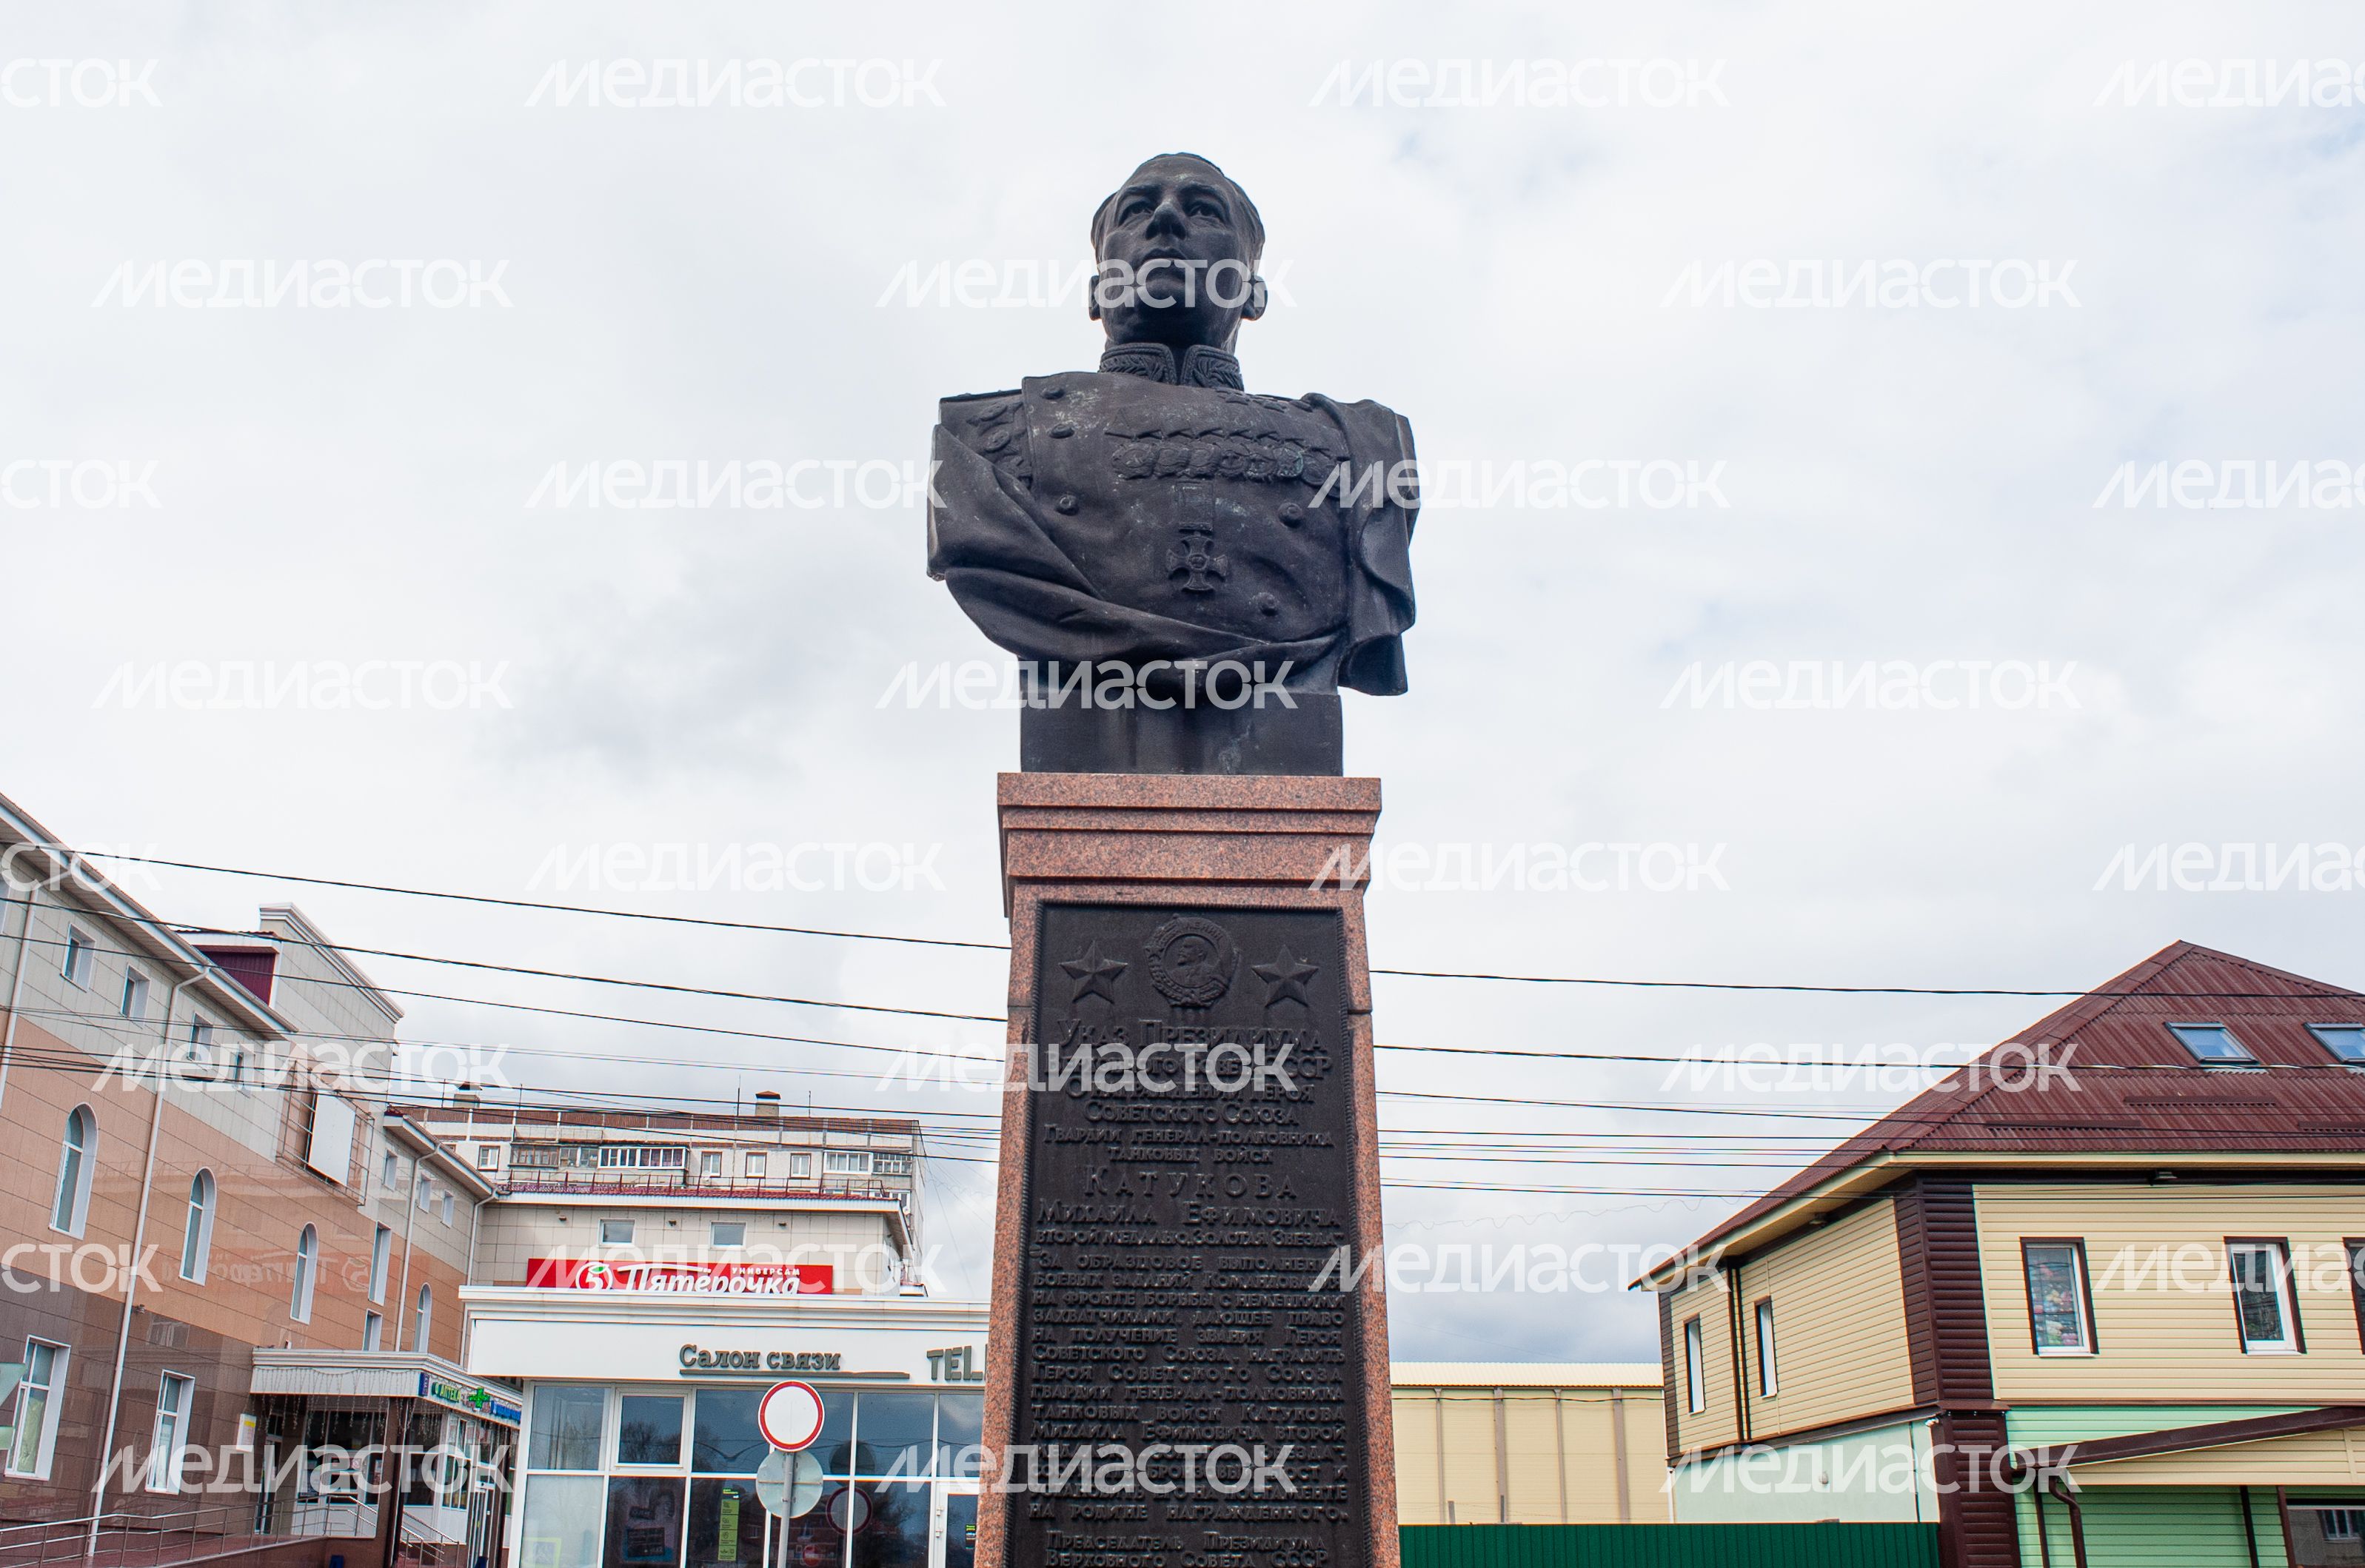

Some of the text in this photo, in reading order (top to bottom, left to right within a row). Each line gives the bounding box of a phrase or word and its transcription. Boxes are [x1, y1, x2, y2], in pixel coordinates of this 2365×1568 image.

[1057, 1018, 1327, 1053] УКАЗ ПРЕЗИДИУМА
[1084, 1100, 1299, 1125] СОВЕТСКОГО СОЮЗА
[1043, 1123, 1122, 1144] ГВАРДИИ
[1108, 1145, 1274, 1165] ТАНКОВЫХ ВОЙСК
[1083, 1164, 1299, 1199] КАТУКОВА
[1037, 1198, 1341, 1227] МИХАИЛА ЕФИМОВИЧА
[1034, 1225, 1099, 1246] ВТОРОЙ
[1038, 1250, 1342, 1271] ЗА ОБРАЗЦОВОЕ ВЫПОЛНЕНИЕ
[732, 1267, 801, 1276] УНИВЕРСАМ
[1032, 1271, 1103, 1287] БОЕВЫХ
[1111, 1270, 1193, 1288] ЗАДАНИЙ
[1031, 1290, 1345, 1310] НА ФРОНТЕ БОРЬБЫ С НЕМЕЦКИМИ
[1192, 1310, 1274, 1327] ДАЮЩЕЕ
[1287, 1310, 1345, 1327] ПРАВО
[1031, 1326, 1342, 1345] НА ПОЛУЧЕНИЕ ЗВАНИЯ ГЕРОЯ
[679, 1344, 842, 1371] Салон связи
[926, 1344, 989, 1381] TEL
[1031, 1344, 1147, 1361] СОВЕТСКОГО
[1248, 1347, 1345, 1363] НАГРАДИТЬ
[1031, 1361, 1343, 1382] ГЕРОЯ СОВЕТСКОГО СОЮЗА
[1030, 1384, 1344, 1401] ГВАРДИИ ГЕНЕРАЛ-ПОЛКОВНИКА
[1031, 1401, 1346, 1423] ТАНКОВЫХ ВОЙСК КАТУКОВА
[1030, 1419, 1346, 1442] МИХАИЛА ЕФИМОВИЧА ВТОРОЙ
[1332, 1466, 1348, 1481] И
[1028, 1503, 1056, 1519] НА
[1070, 1503, 1149, 1521] РОДИНЕ
[1046, 1529, 1327, 1552] ПРЕДСЕДАТЕЛЬ ПРЕЗИДИУМА
[1045, 1549, 1329, 1568] ВЕРХОВНОГО СОВЕТА СССР
